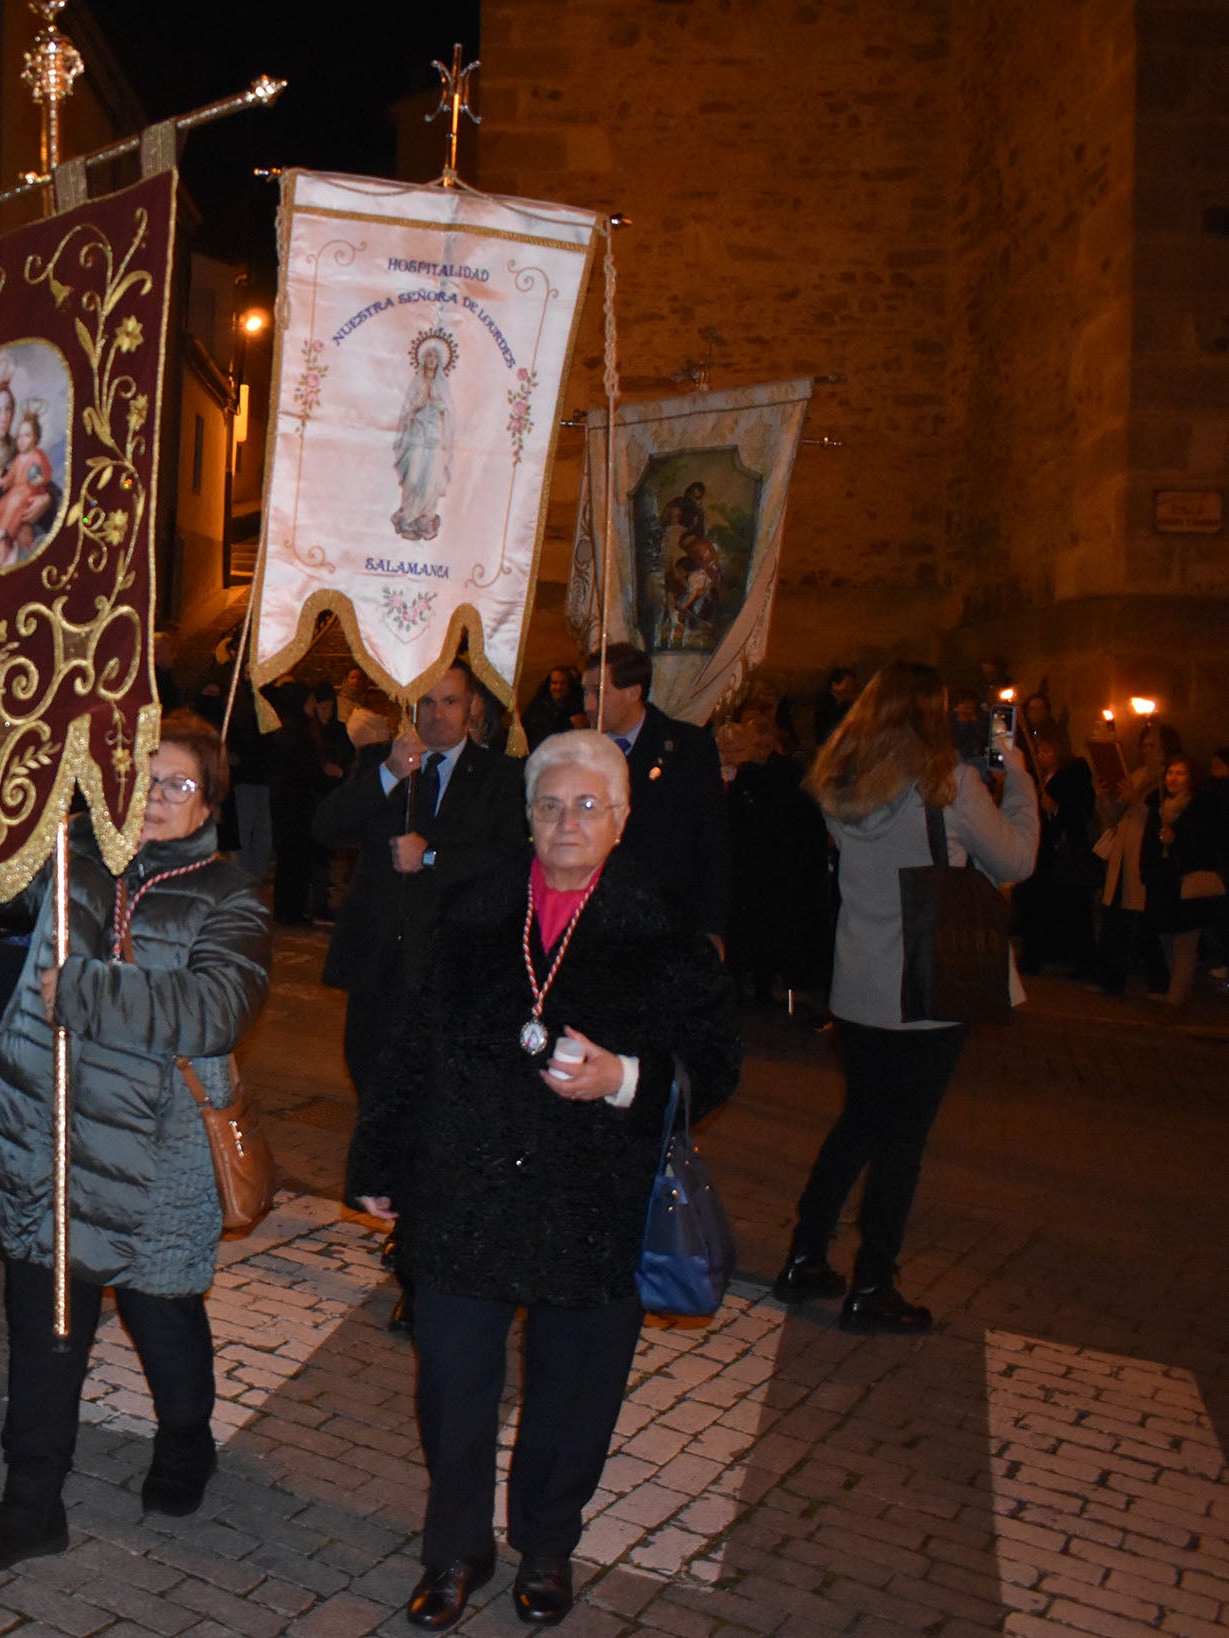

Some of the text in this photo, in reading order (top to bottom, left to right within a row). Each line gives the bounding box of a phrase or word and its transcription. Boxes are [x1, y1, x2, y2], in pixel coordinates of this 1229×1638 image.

[387, 257, 490, 283] HOSPITALIDAD
[332, 288, 517, 369] NUESTRA SEÑORA DE LOURDES
[364, 557, 450, 579] SALAMANCA
